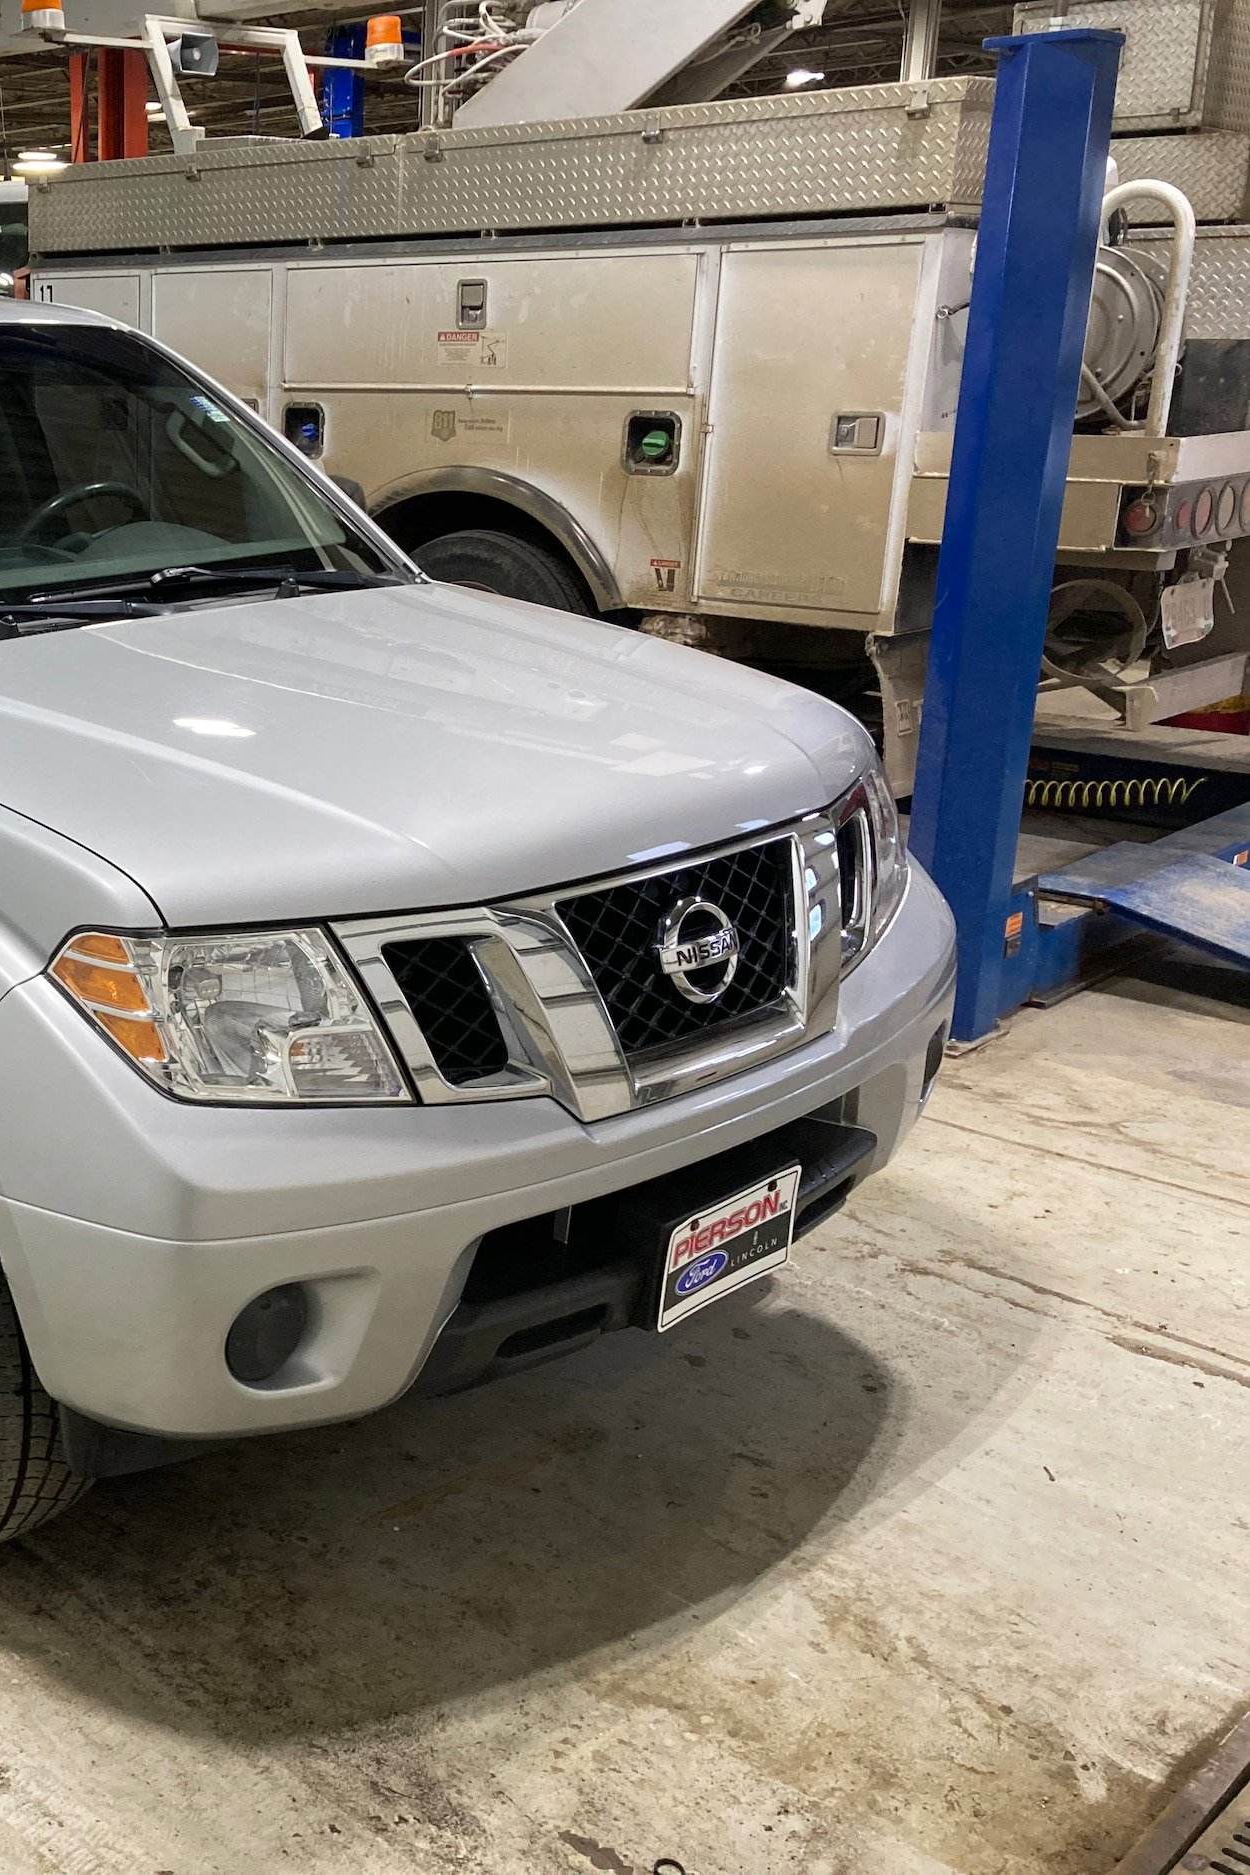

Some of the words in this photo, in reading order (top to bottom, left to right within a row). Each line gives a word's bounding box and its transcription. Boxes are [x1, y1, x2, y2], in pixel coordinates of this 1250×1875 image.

[446, 333, 478, 341] DANGER
[433, 410, 455, 430] 811
[675, 928, 739, 967] NISSAN
[672, 1190, 781, 1270] PIERSON
[730, 1237, 778, 1267] LINCOLN
[684, 1258, 719, 1289] Ford
